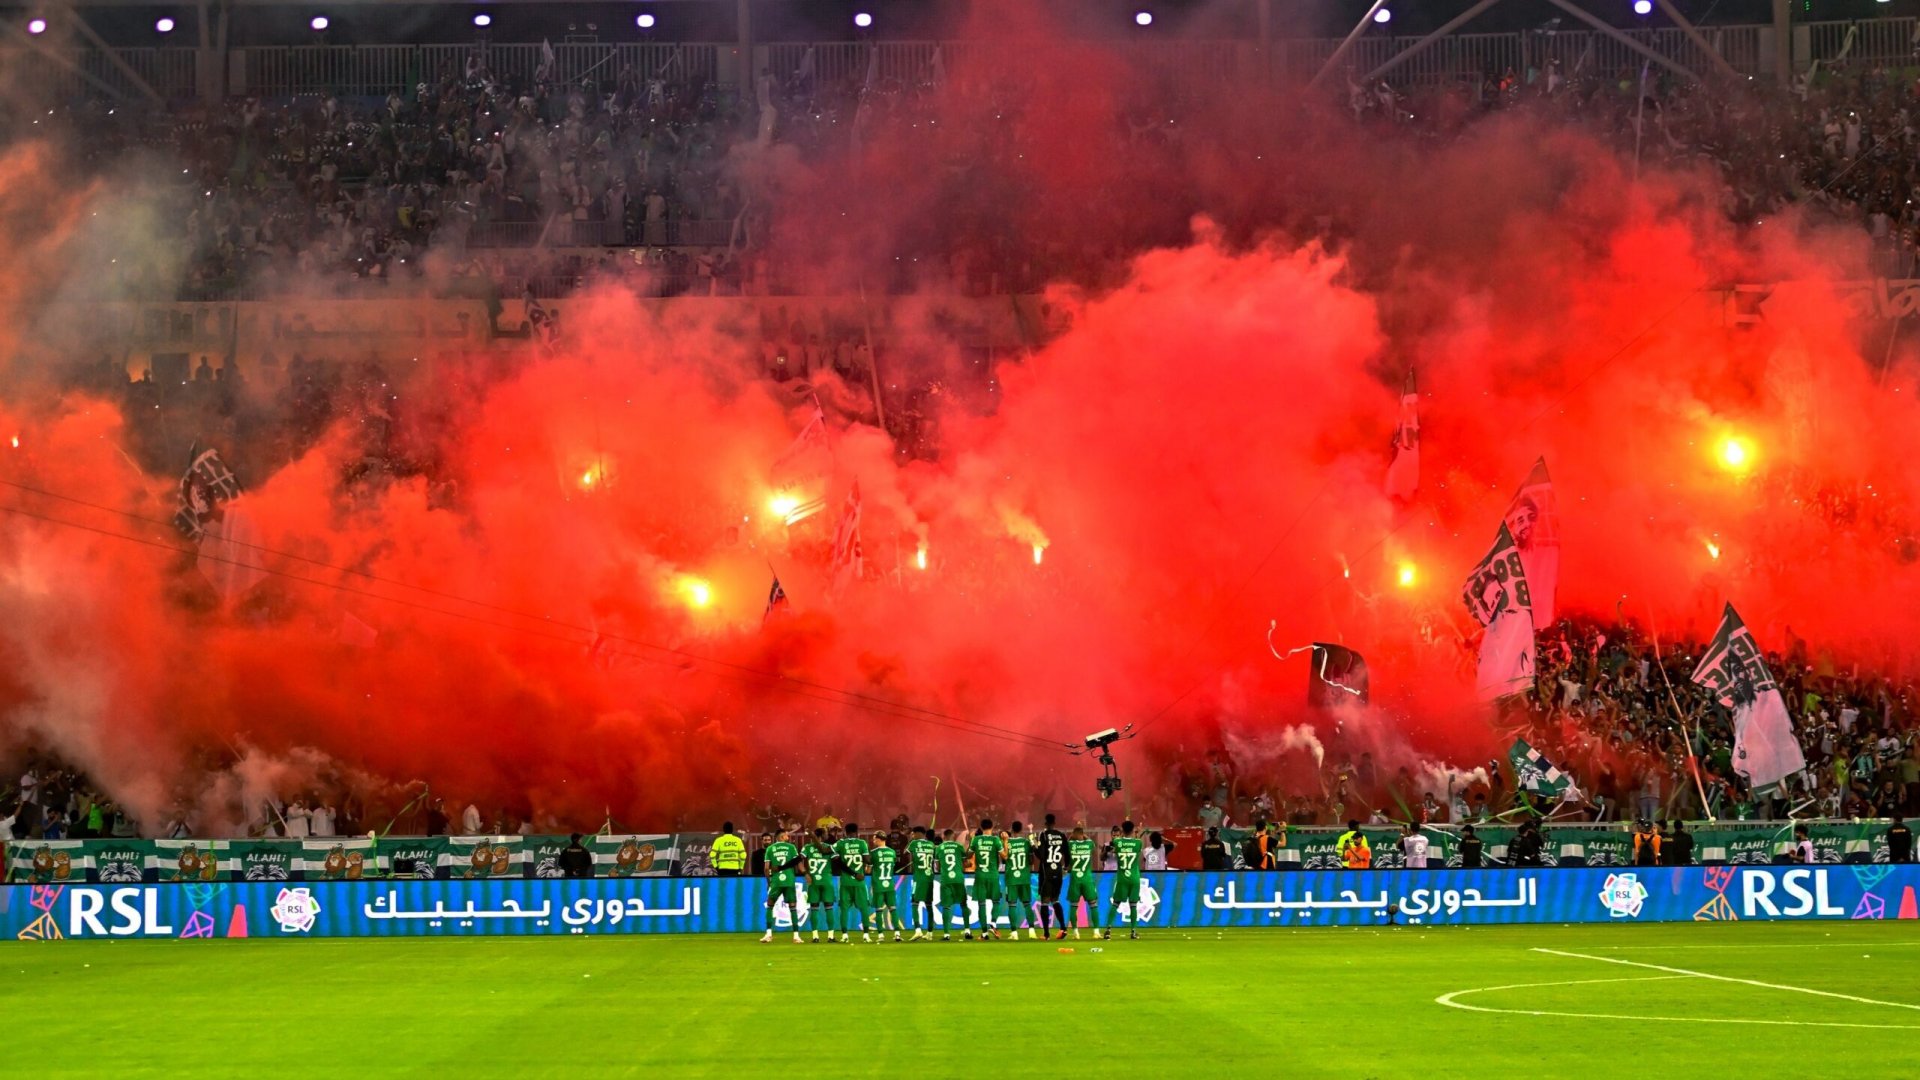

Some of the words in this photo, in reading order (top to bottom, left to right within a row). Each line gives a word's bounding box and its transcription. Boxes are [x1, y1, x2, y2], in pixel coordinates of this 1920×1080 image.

[917, 853, 933, 869] 30
[945, 854, 956, 871] 9
[979, 851, 990, 868] 3
[1010, 853, 1026, 871] 10
[1046, 845, 1063, 863] 16
[1118, 852, 1137, 870] 37
[808, 858, 828, 874] 97
[844, 854, 863, 872] 79
[879, 863, 892, 880] 11
[1071, 854, 1091, 872] 27
[1615, 890, 1631, 899] RSL
[1743, 869, 1845, 916] RSL
[71, 887, 172, 935] RSL
[287, 905, 304, 914] RSL
